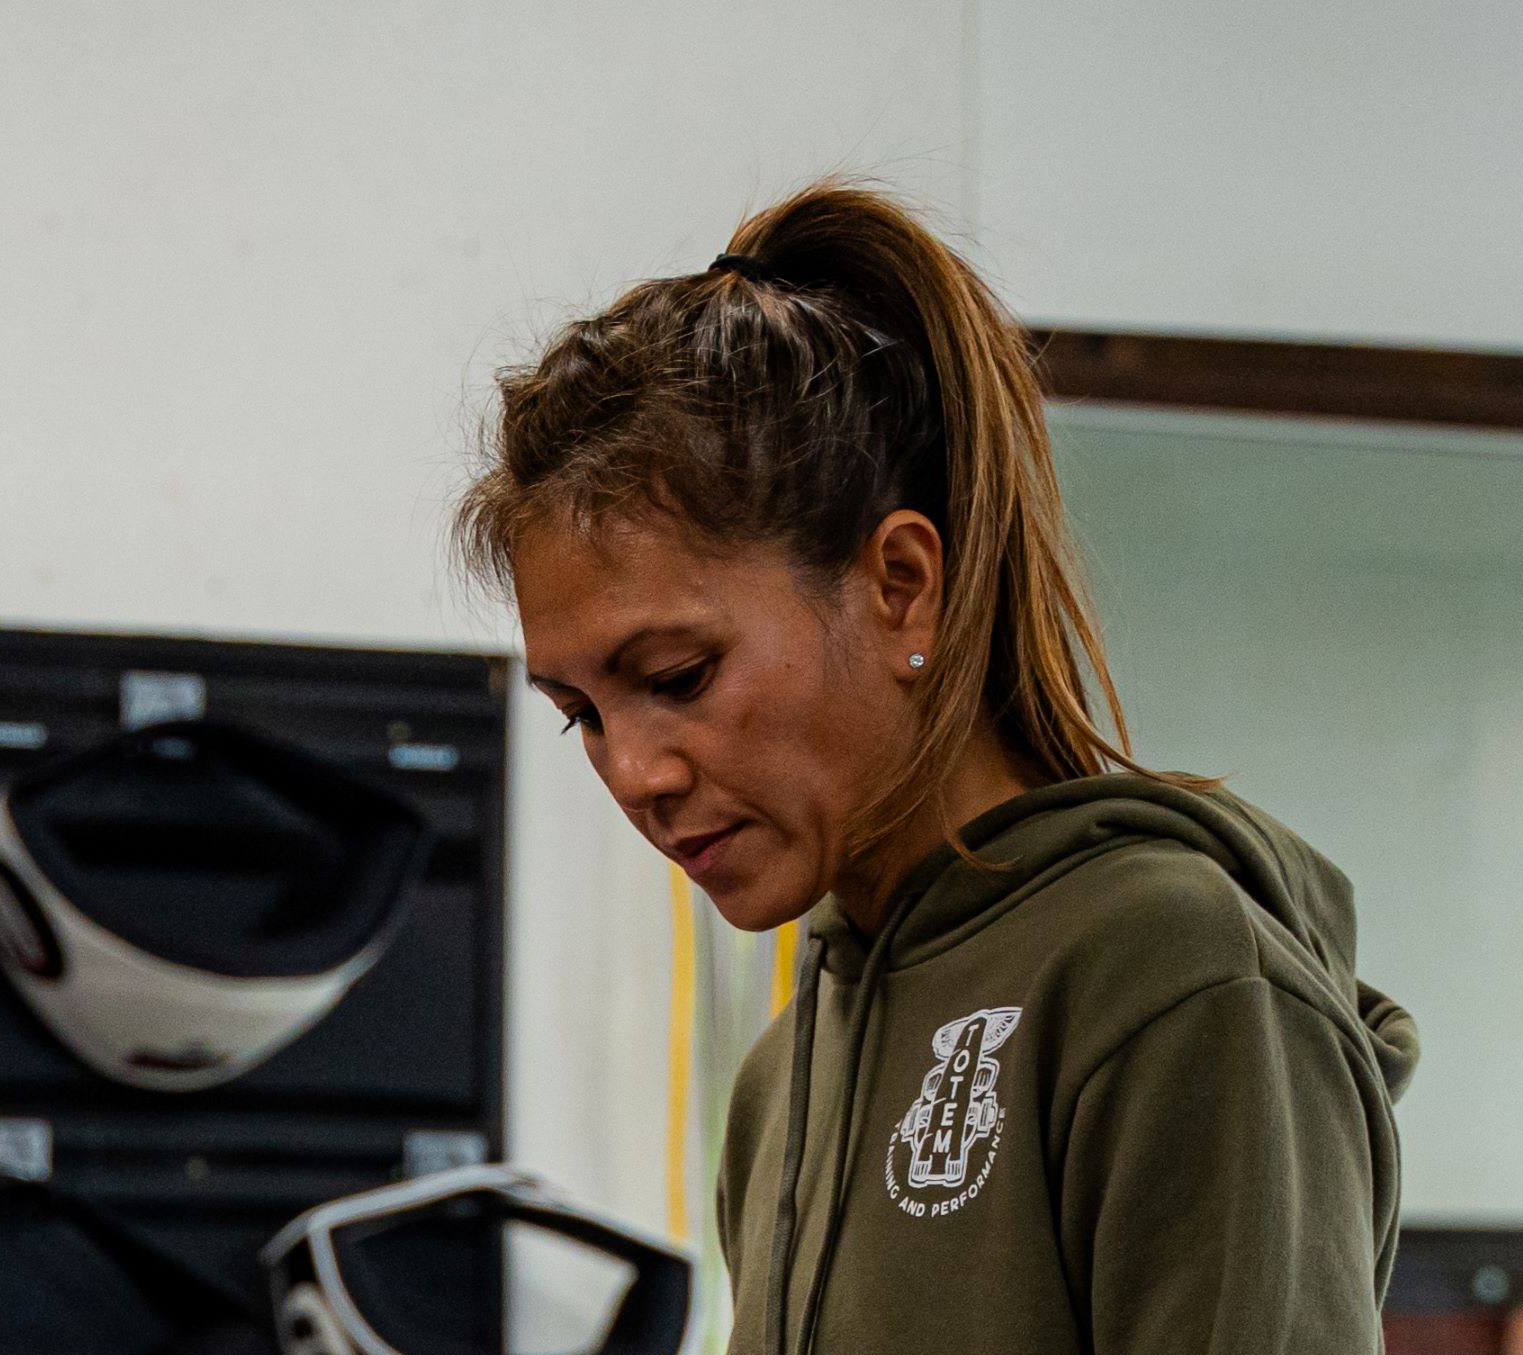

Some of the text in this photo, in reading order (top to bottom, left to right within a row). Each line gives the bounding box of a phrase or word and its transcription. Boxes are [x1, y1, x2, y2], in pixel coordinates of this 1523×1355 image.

[931, 1023, 979, 1154] TOTEM
[898, 1196, 926, 1218] AND
[930, 1107, 1007, 1218] PERFORMANCE
